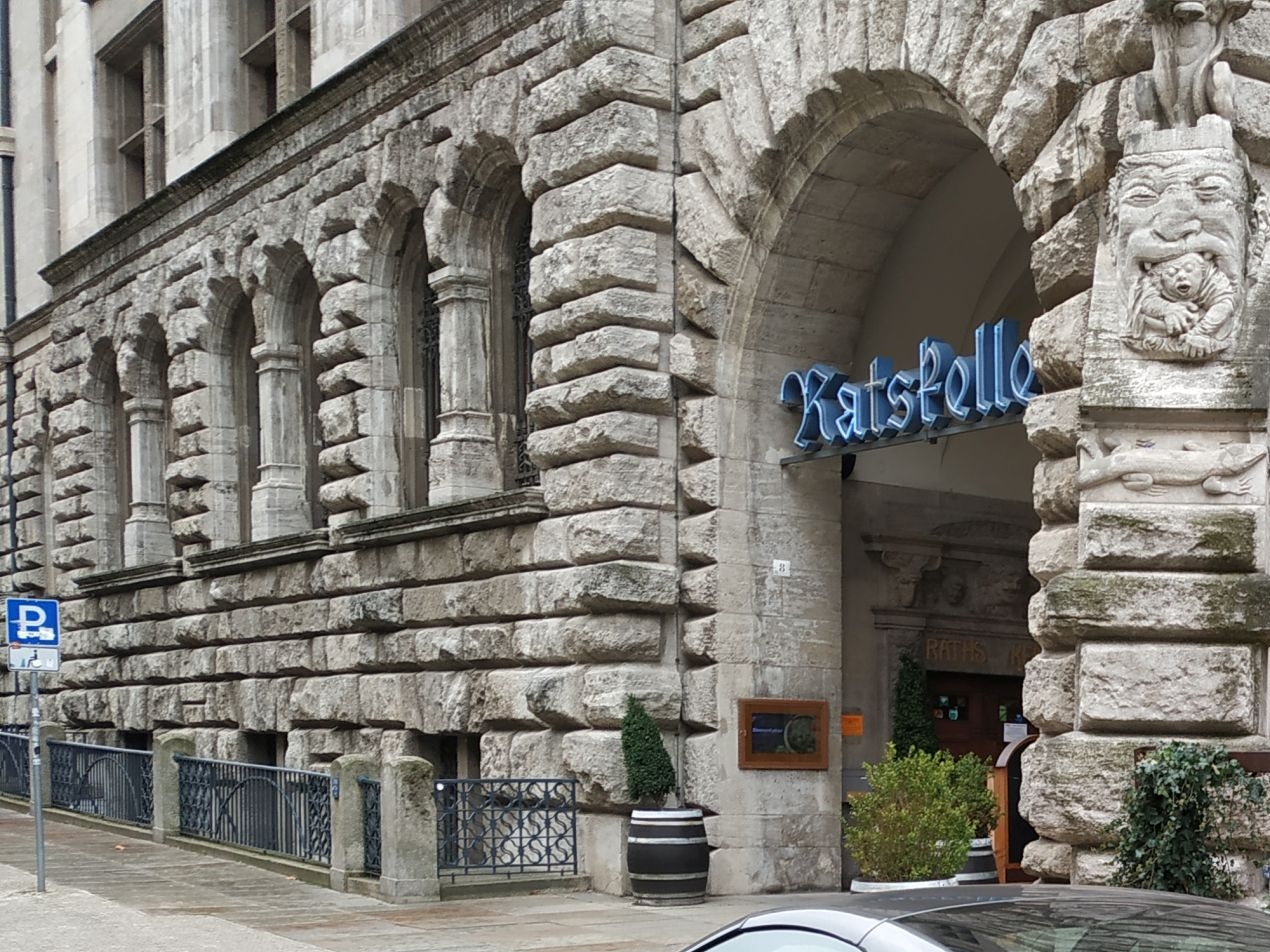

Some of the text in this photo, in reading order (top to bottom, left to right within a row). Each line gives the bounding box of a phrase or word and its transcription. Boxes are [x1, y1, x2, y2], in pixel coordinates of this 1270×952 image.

[780, 318, 1041, 450] Ratskelle
[19, 604, 47, 633] P
[926, 638, 987, 664] RATHS
